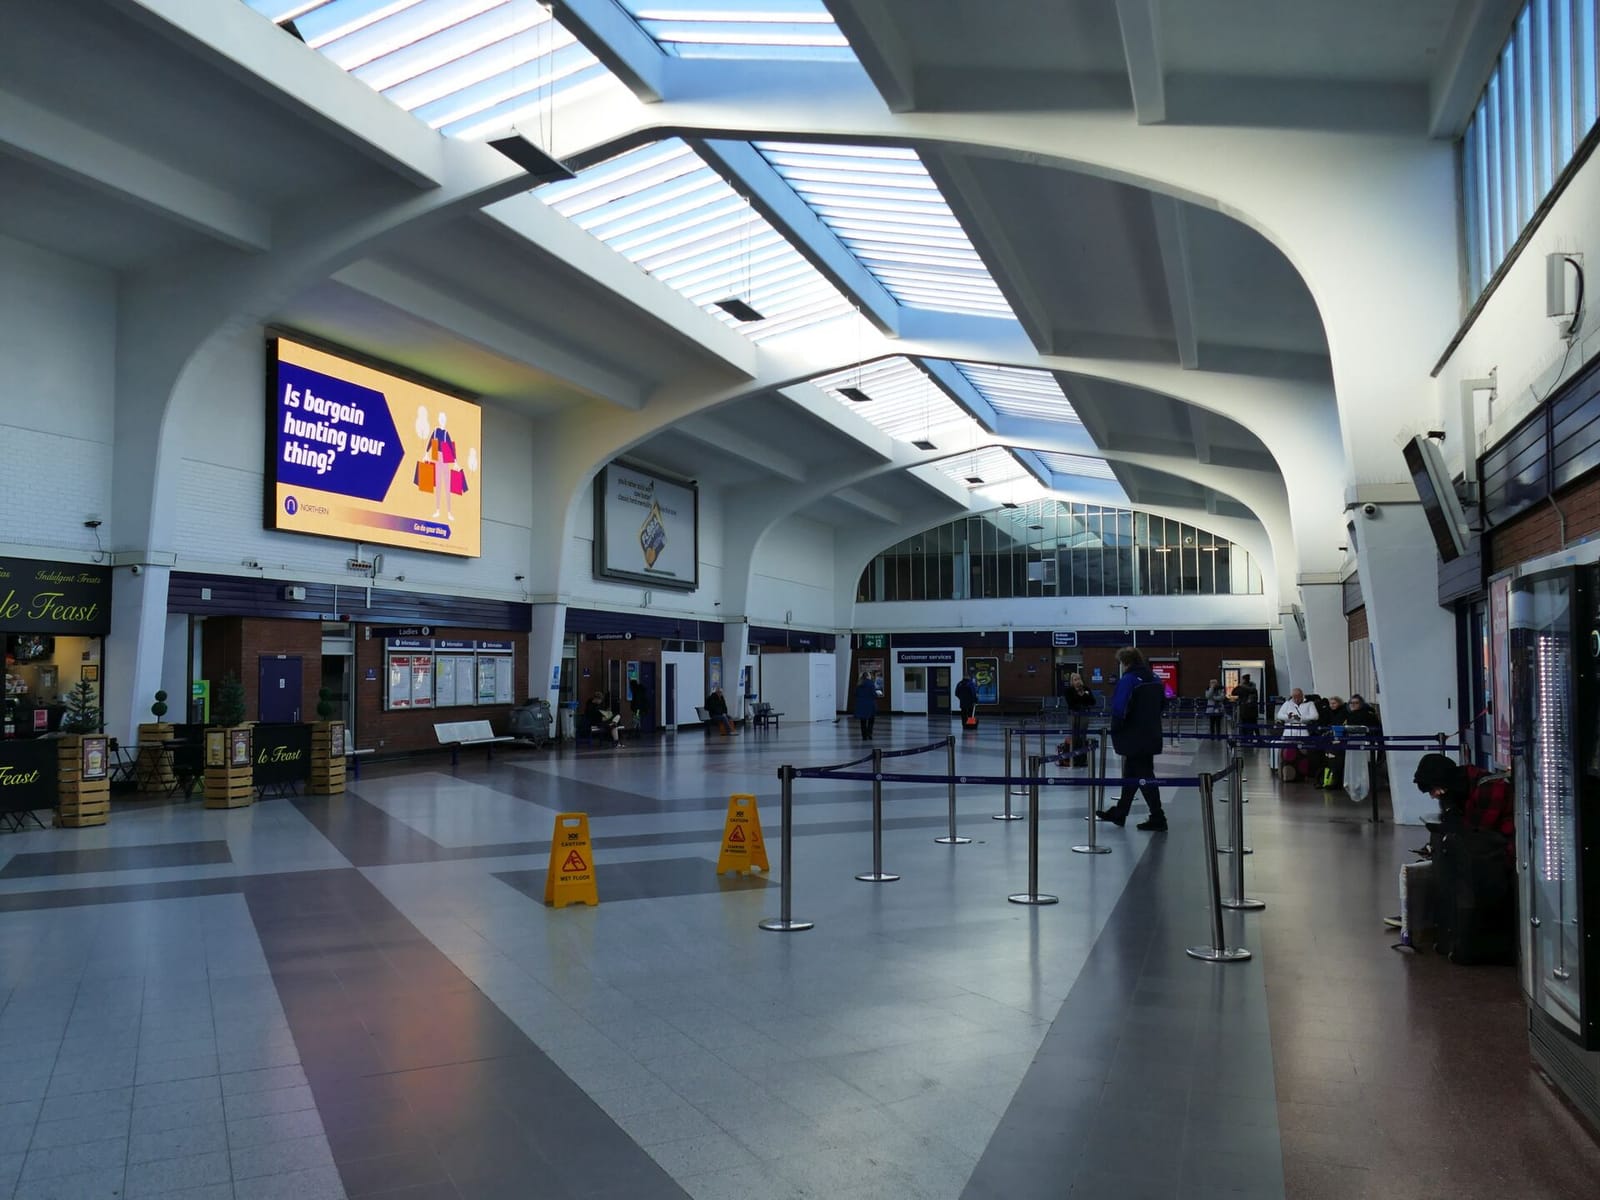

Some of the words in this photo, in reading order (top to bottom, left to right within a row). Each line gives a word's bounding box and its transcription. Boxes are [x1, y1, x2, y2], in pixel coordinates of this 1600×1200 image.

[284, 383, 300, 408] Is
[304, 389, 365, 426] bargain
[284, 411, 347, 453] hunting
[350, 433, 386, 457] your
[284, 441, 336, 475] thing?
[301, 503, 329, 515] NORTHERN
[436, 527, 447, 537] thing
[35, 570, 74, 584] Indulgent
[77, 573, 102, 584] Treats
[27, 592, 100, 622] Feast
[399, 628, 419, 636] Ladies
[257, 748, 268, 765] le
[270, 745, 303, 763] Feast
